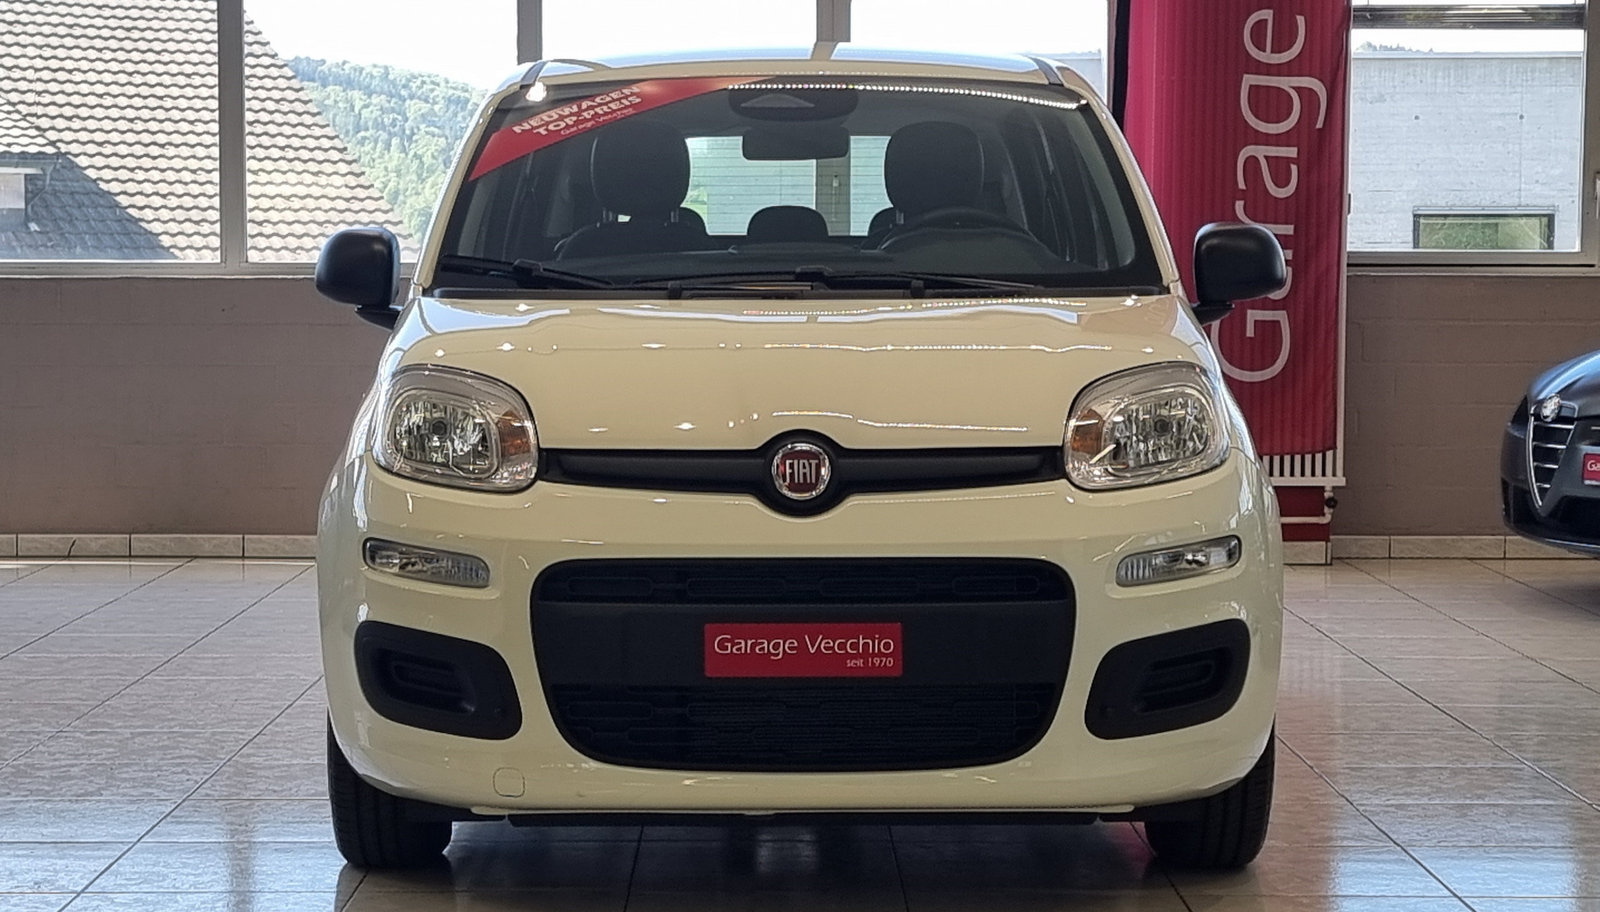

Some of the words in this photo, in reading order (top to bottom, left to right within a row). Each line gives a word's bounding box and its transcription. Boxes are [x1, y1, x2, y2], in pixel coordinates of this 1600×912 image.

[512, 86, 641, 134] NEUWAGEN
[533, 95, 642, 136] TOP-PREIS
[1210, 9, 1328, 383] Grage
[785, 459, 819, 484] FIAT
[714, 634, 798, 660] Garage
[804, 634, 894, 654] Vecchio
[846, 657, 864, 668] seit
[868, 657, 894, 668] 1970
